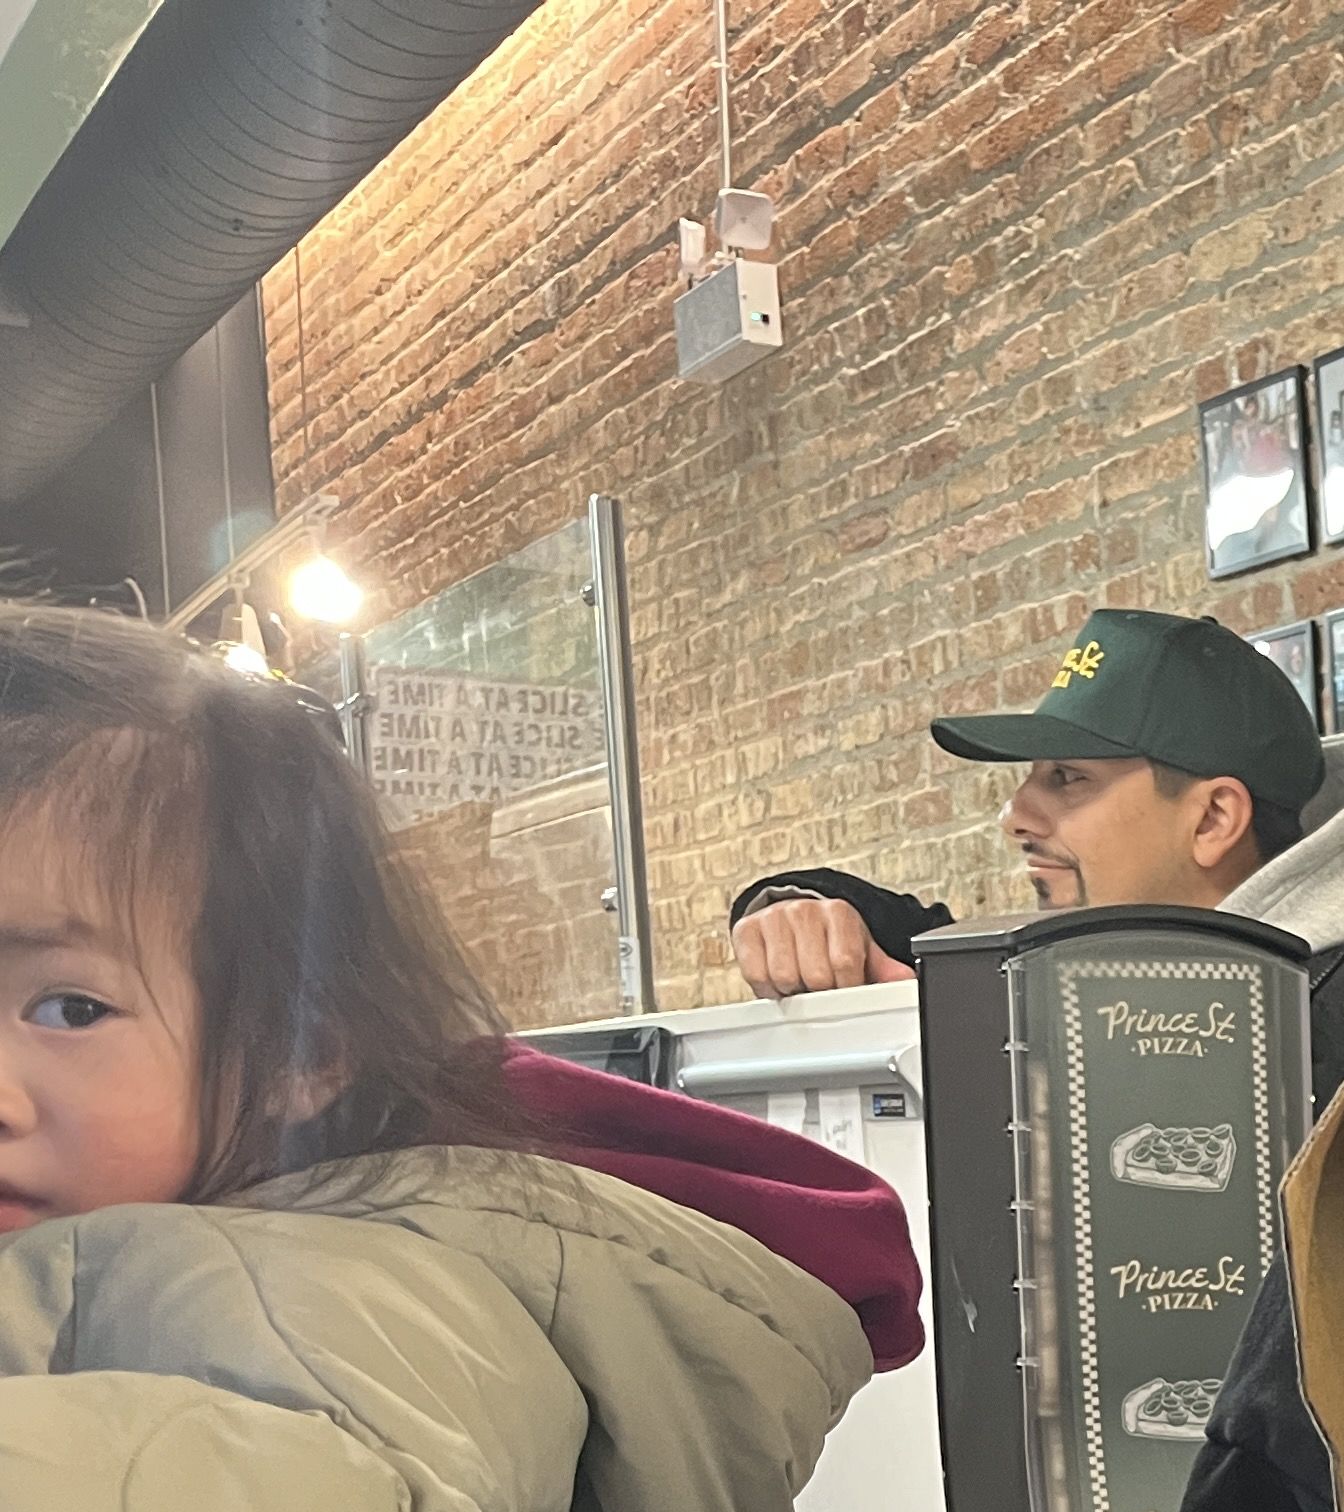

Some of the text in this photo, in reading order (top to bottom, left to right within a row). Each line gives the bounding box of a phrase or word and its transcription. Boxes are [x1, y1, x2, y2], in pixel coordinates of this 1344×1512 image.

[1097, 1001, 1236, 1043] Prince St.
[1110, 1256, 1246, 1298] Prince St.
